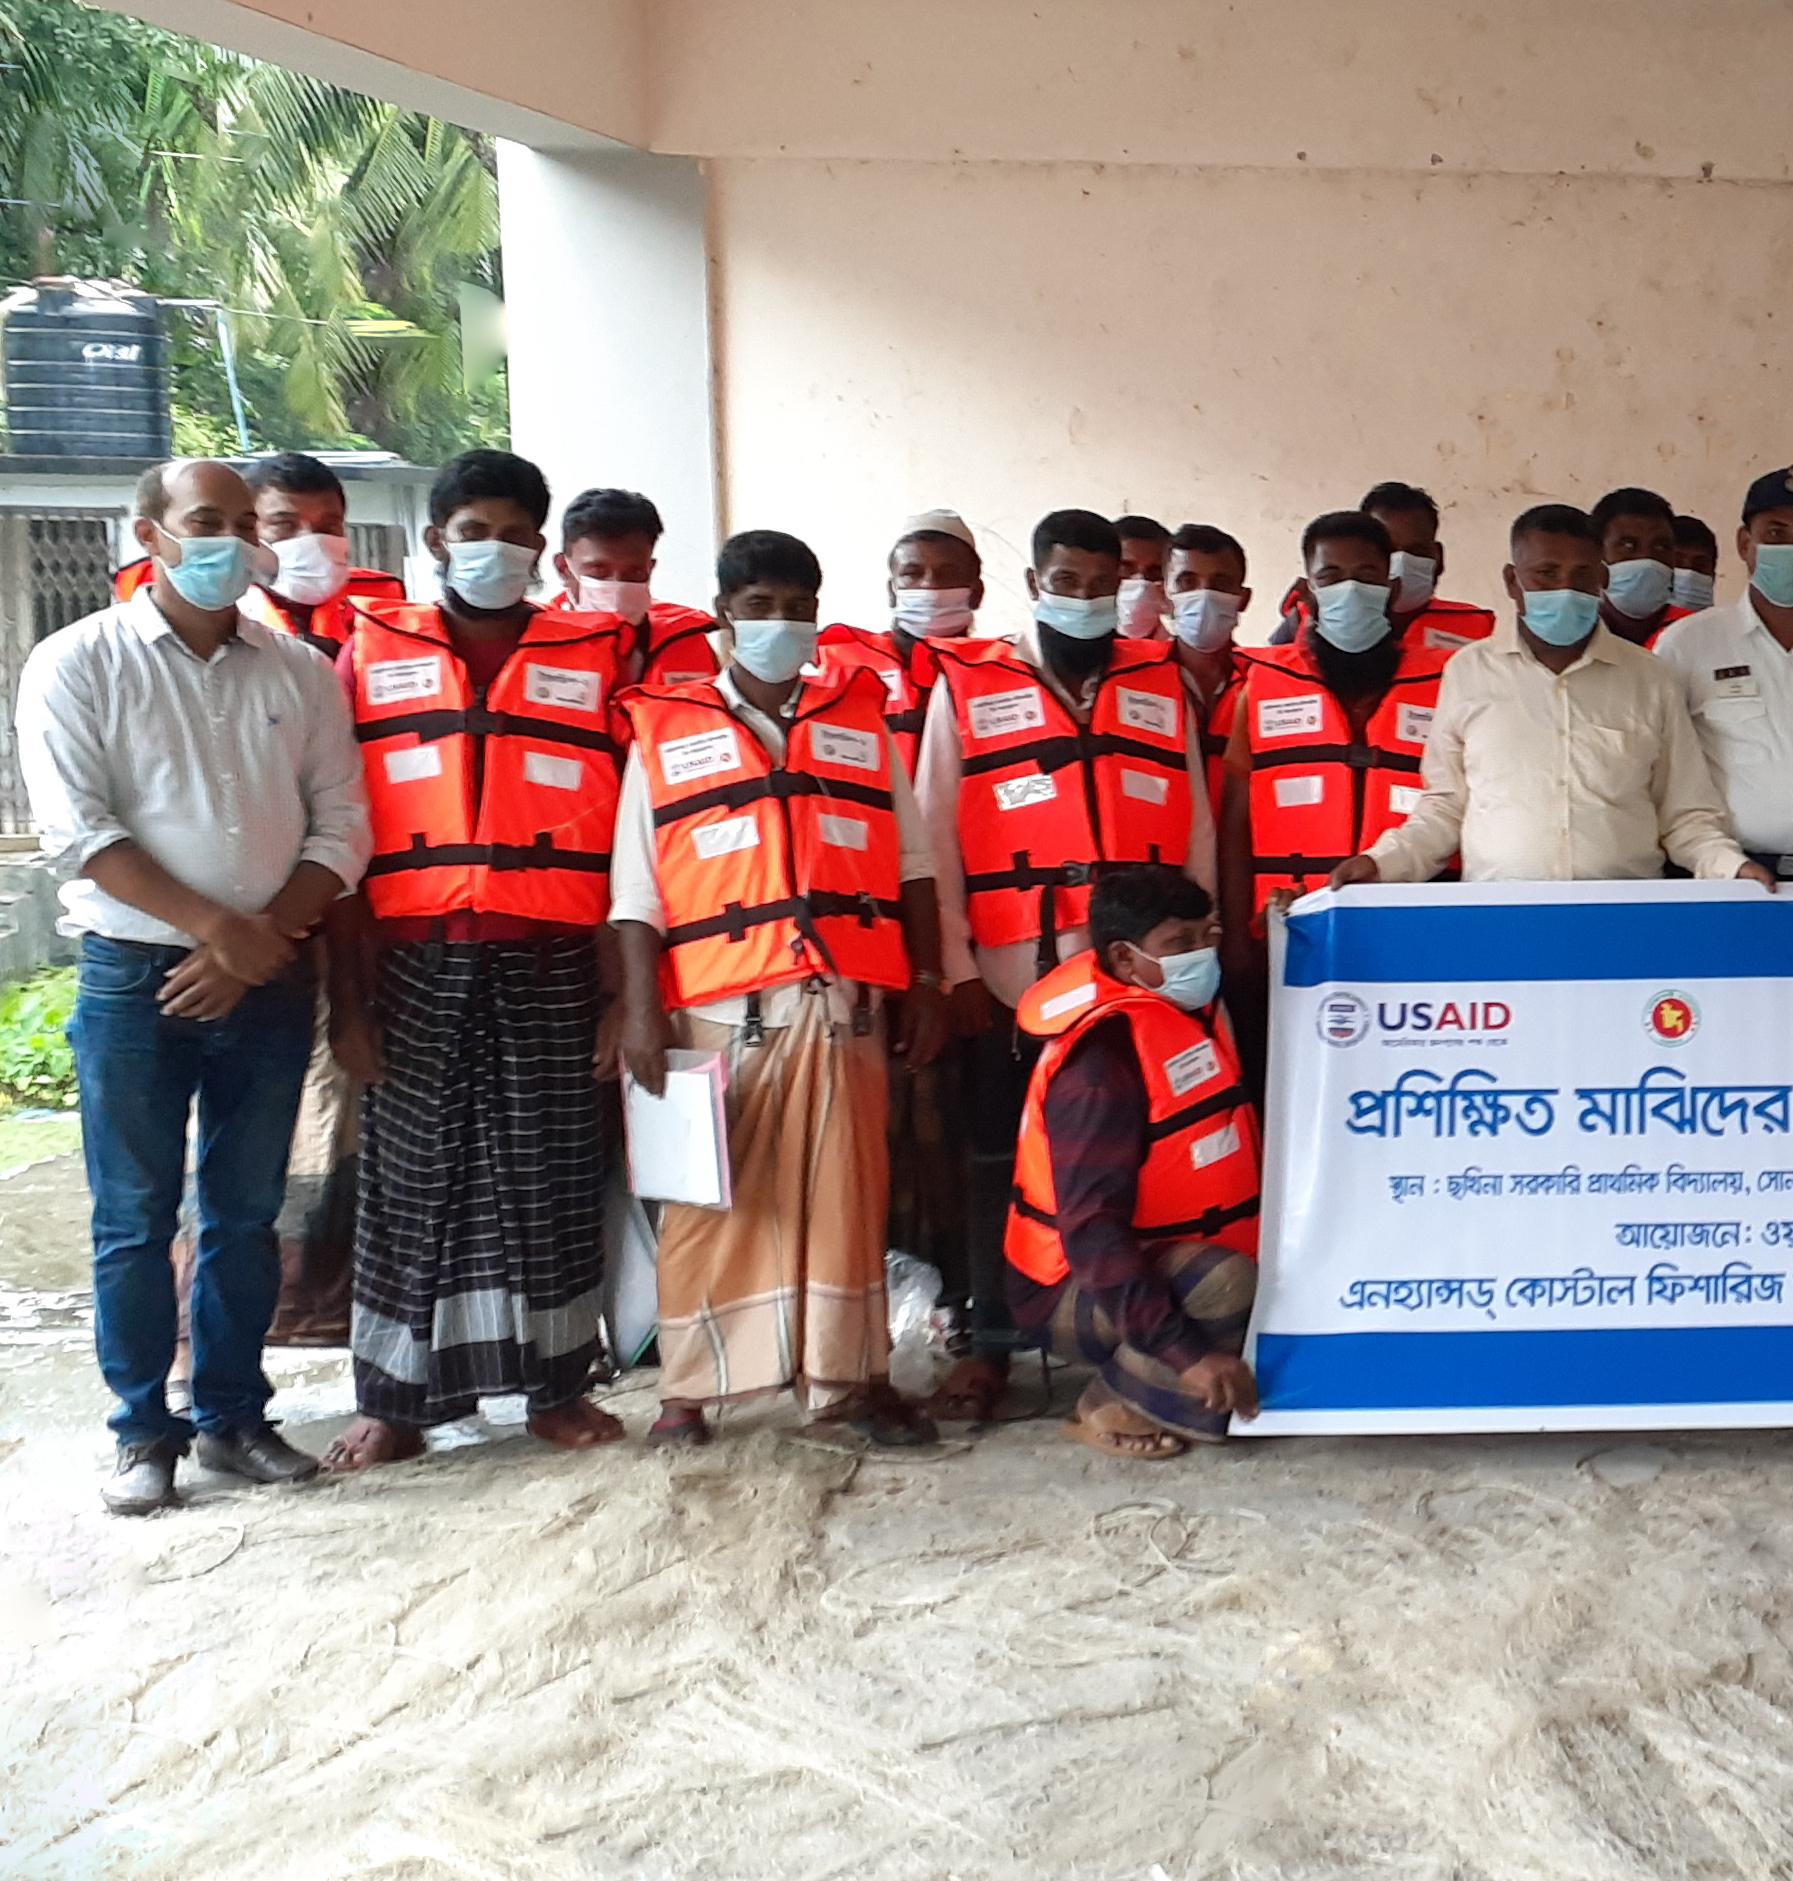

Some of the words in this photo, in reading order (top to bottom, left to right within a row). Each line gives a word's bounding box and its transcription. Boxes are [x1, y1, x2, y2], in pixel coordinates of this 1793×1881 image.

[1377, 1001, 1511, 1032] USAID
[1345, 1068, 1559, 1138] প্রশিক্ষিত
[1573, 1065, 1793, 1137] মাঝিদের
[1509, 1164, 1582, 1195] সরকারি
[1505, 1267, 1638, 1308] কোস্টাল
[1645, 1261, 1786, 1305] ফিশারিজ
